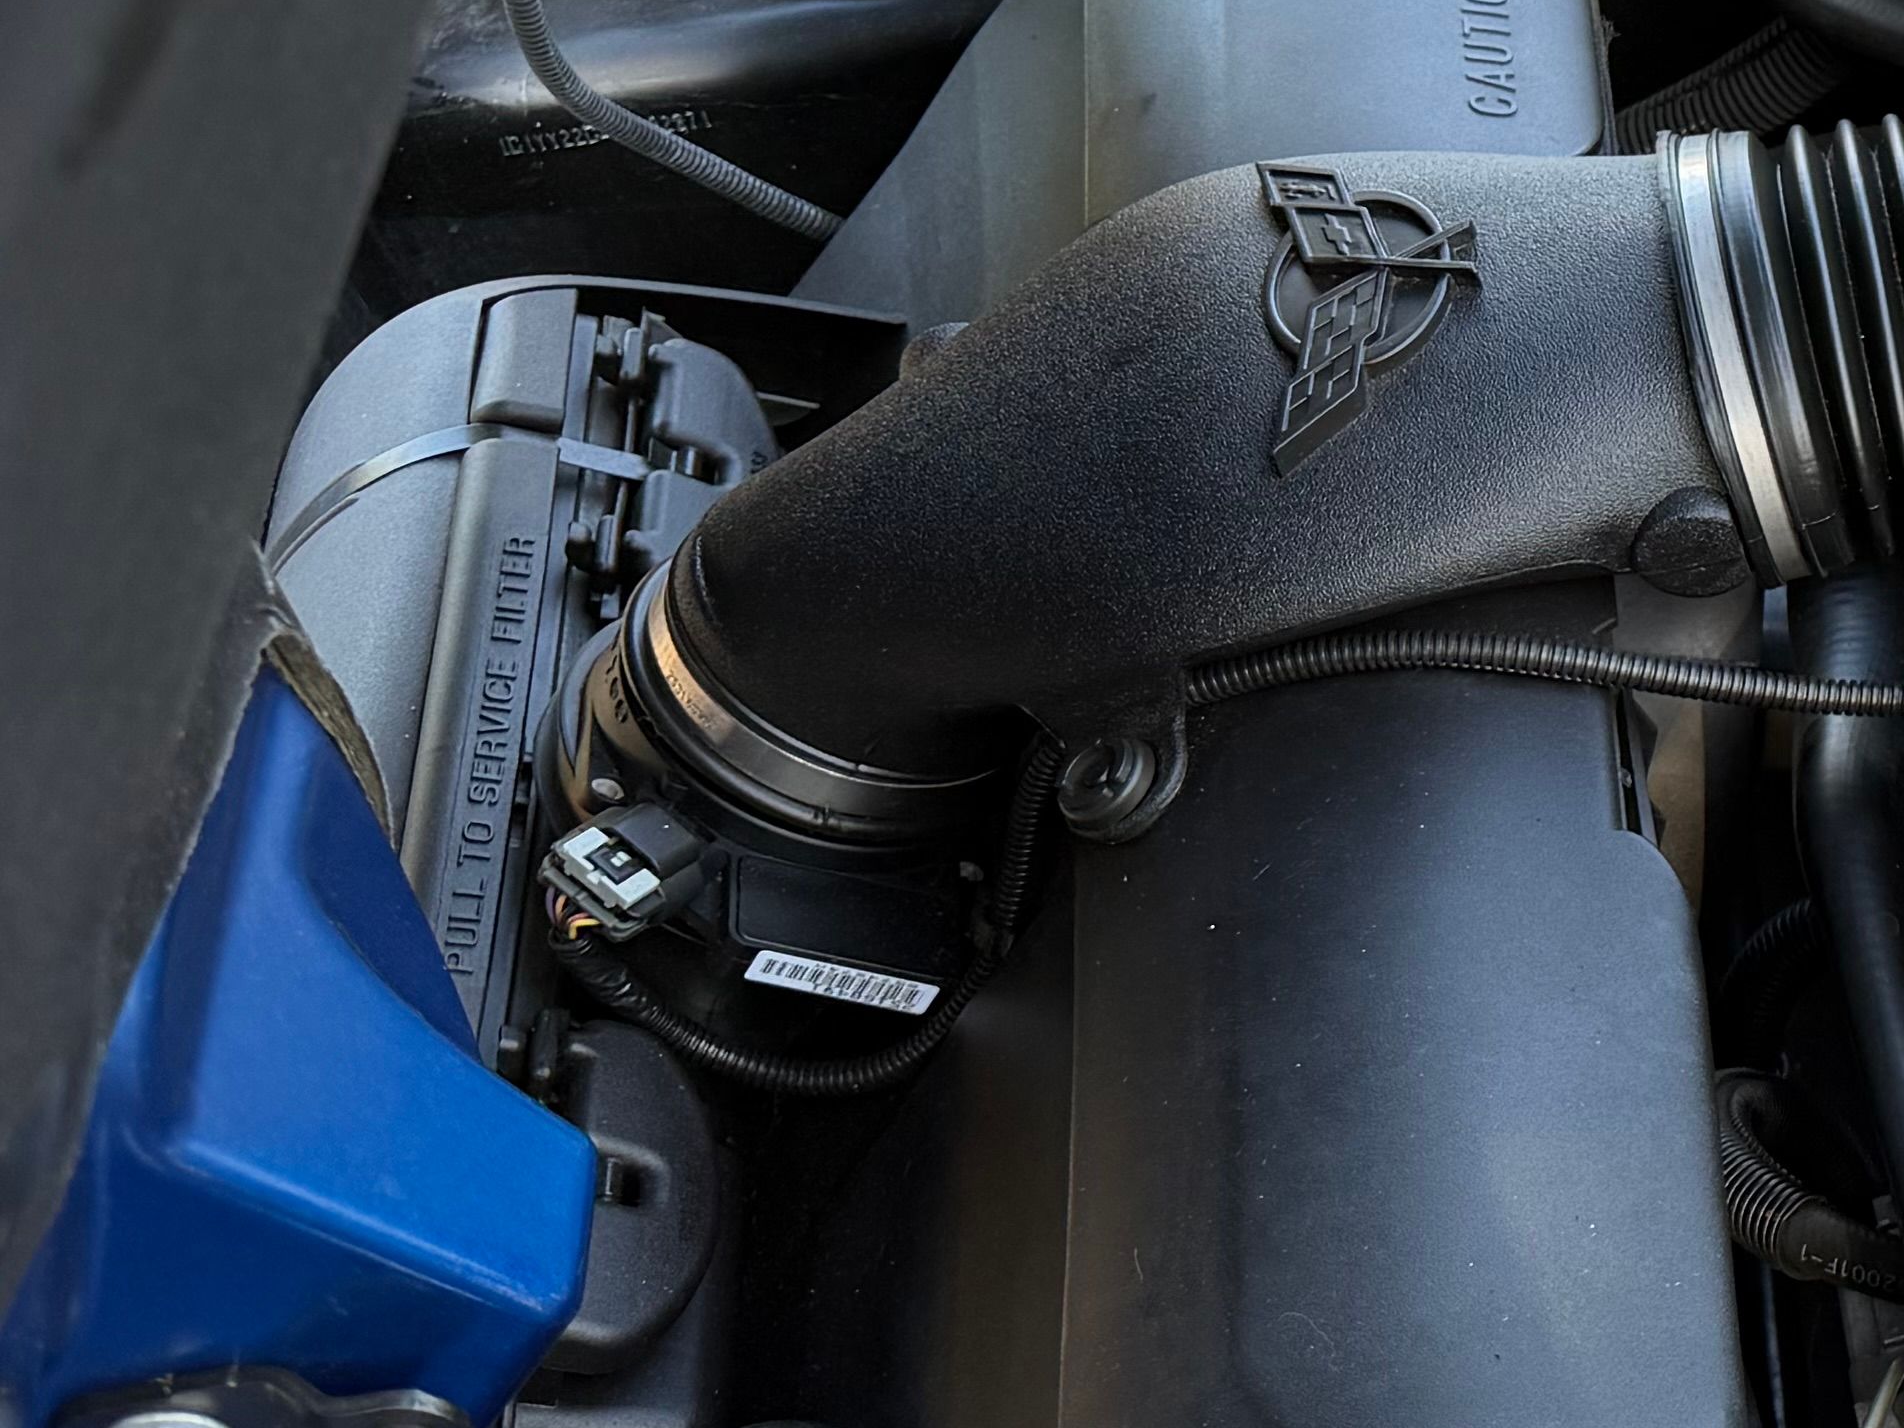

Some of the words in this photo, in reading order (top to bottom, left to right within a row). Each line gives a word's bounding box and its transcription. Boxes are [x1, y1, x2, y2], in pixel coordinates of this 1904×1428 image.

[491, 535, 535, 644] FILTER
[467, 656, 518, 806] SERVICE
[457, 819, 494, 868] TO
[445, 878, 484, 974] PULL
